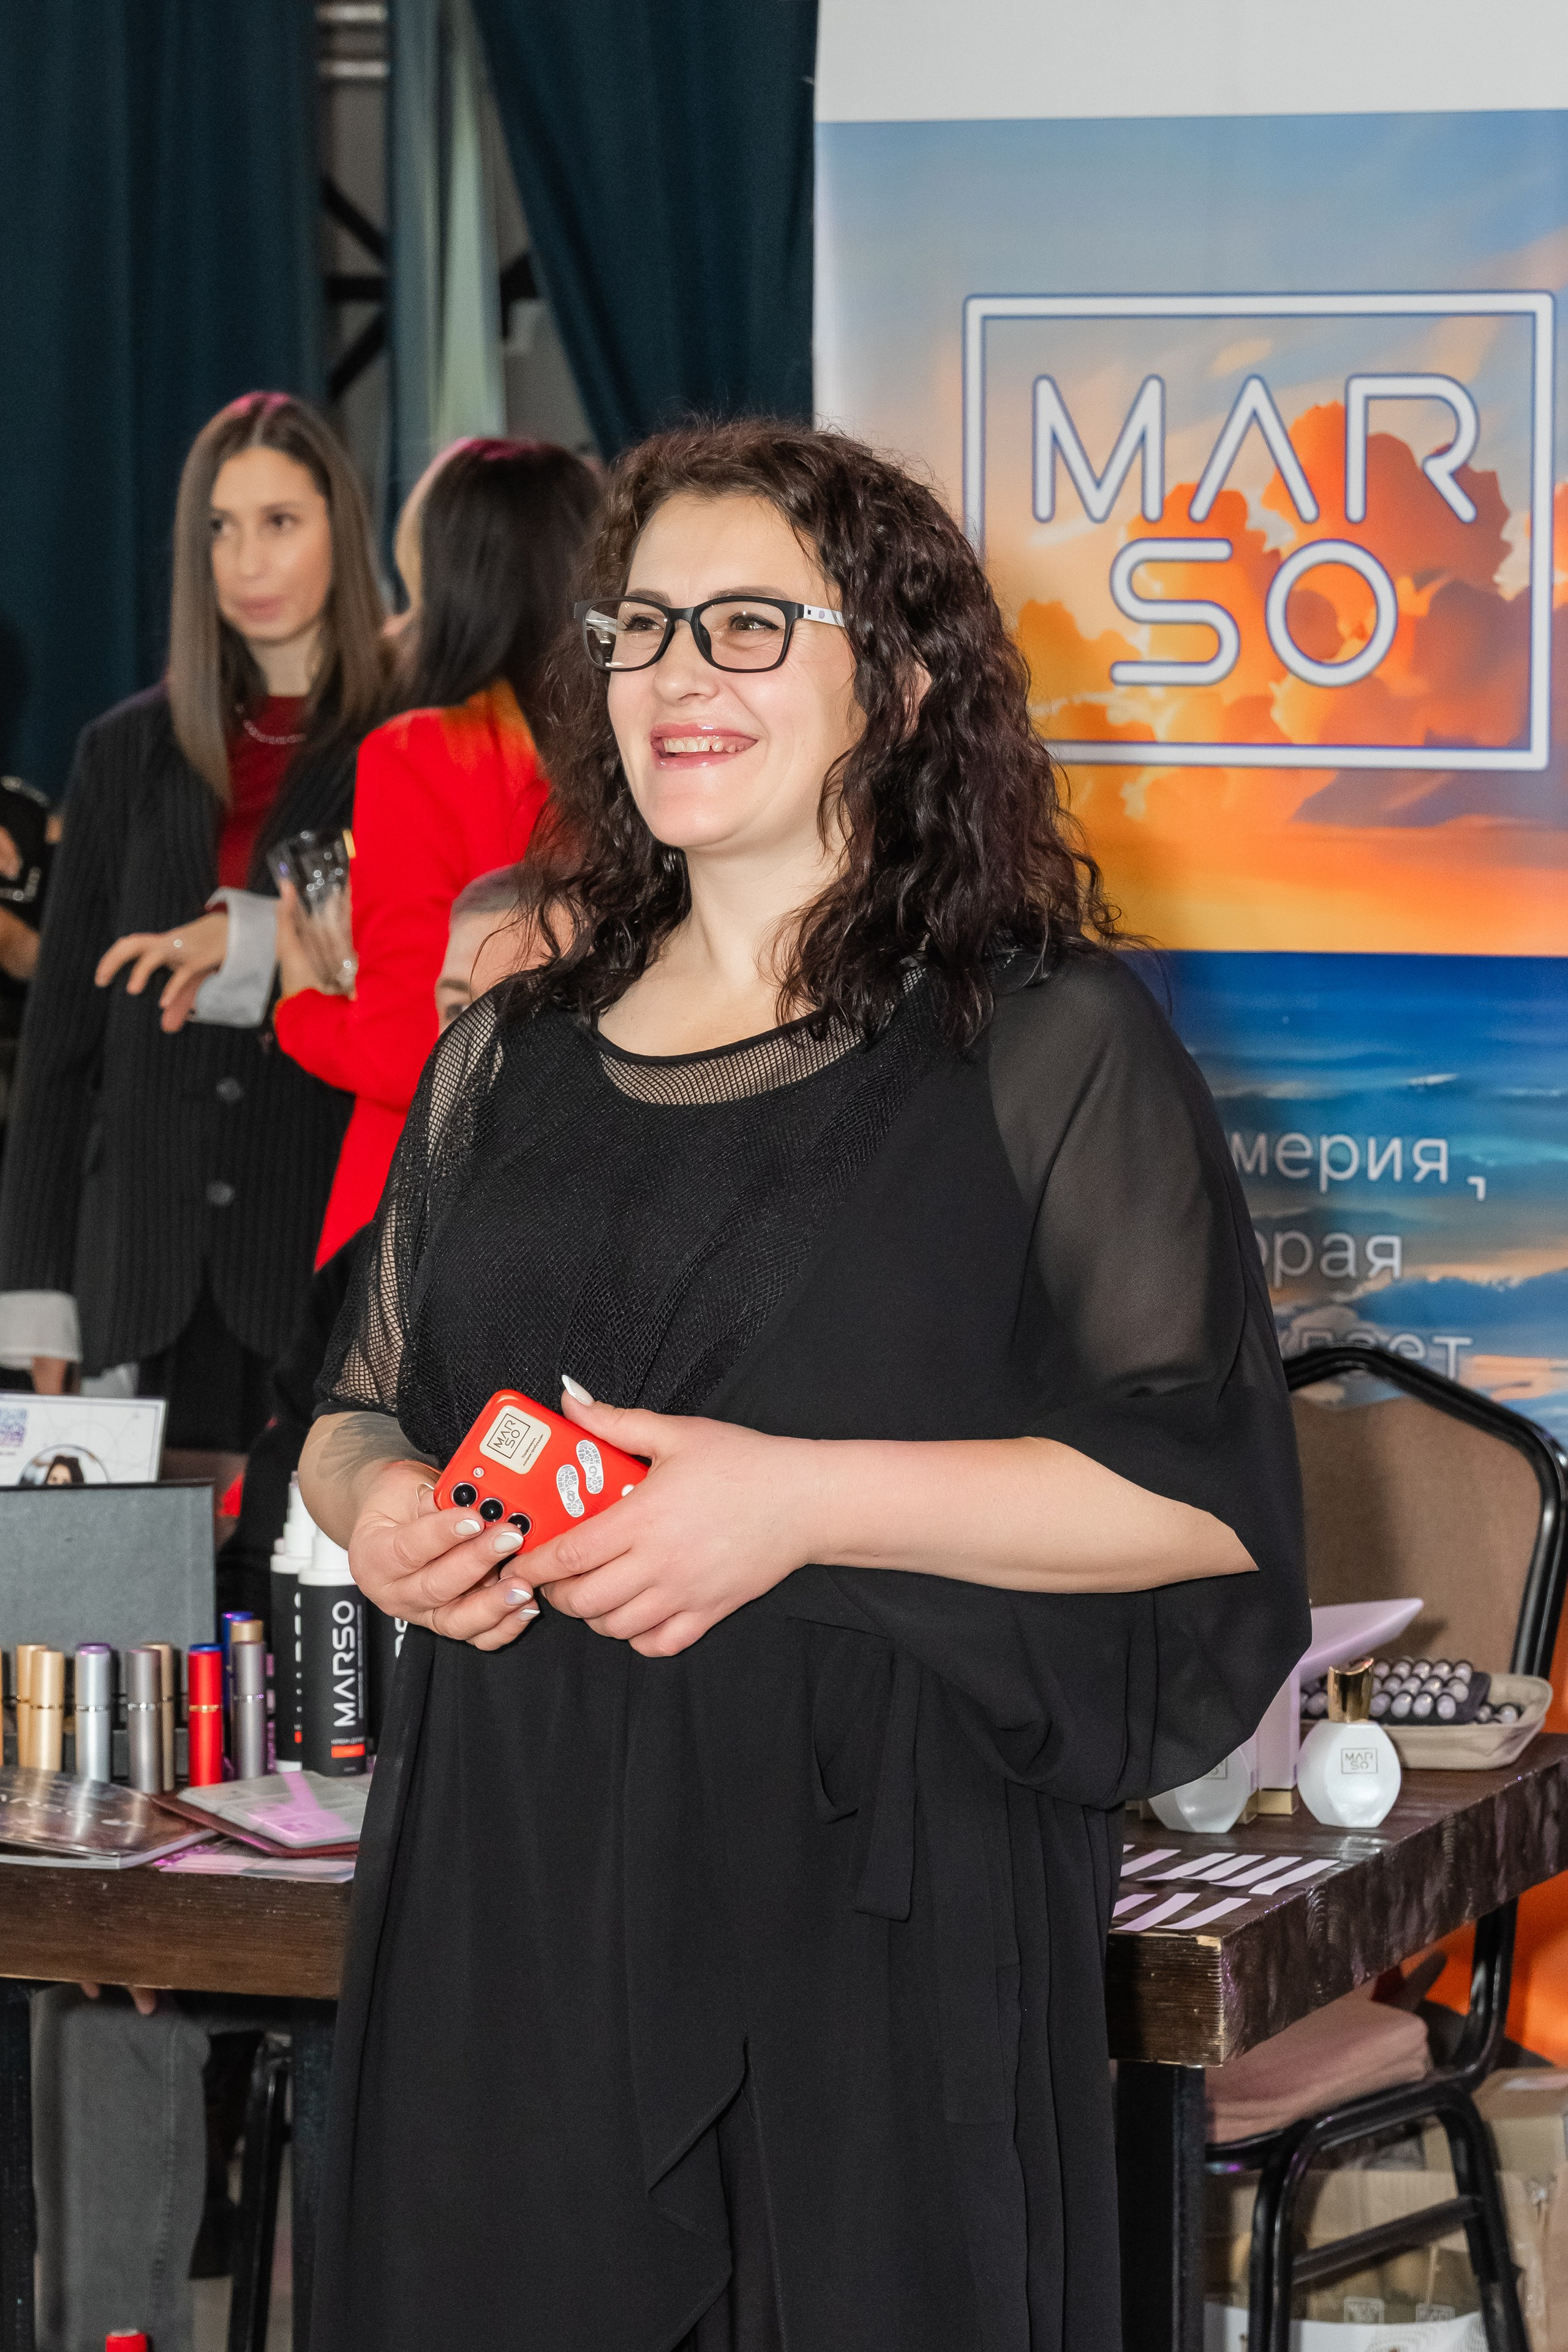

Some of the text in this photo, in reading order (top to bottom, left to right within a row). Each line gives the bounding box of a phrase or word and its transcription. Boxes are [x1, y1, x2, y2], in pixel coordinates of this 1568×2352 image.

[1031, 373, 1478, 524] MAR
[1109, 537, 1398, 687] SO
[493, 1420, 516, 1448] MAR
[505, 1430, 520, 1449] SO
[332, 1600, 356, 1727] MARSO
[1344, 1752, 1373, 1761] MAR
[1351, 1761, 1369, 1770] SO
